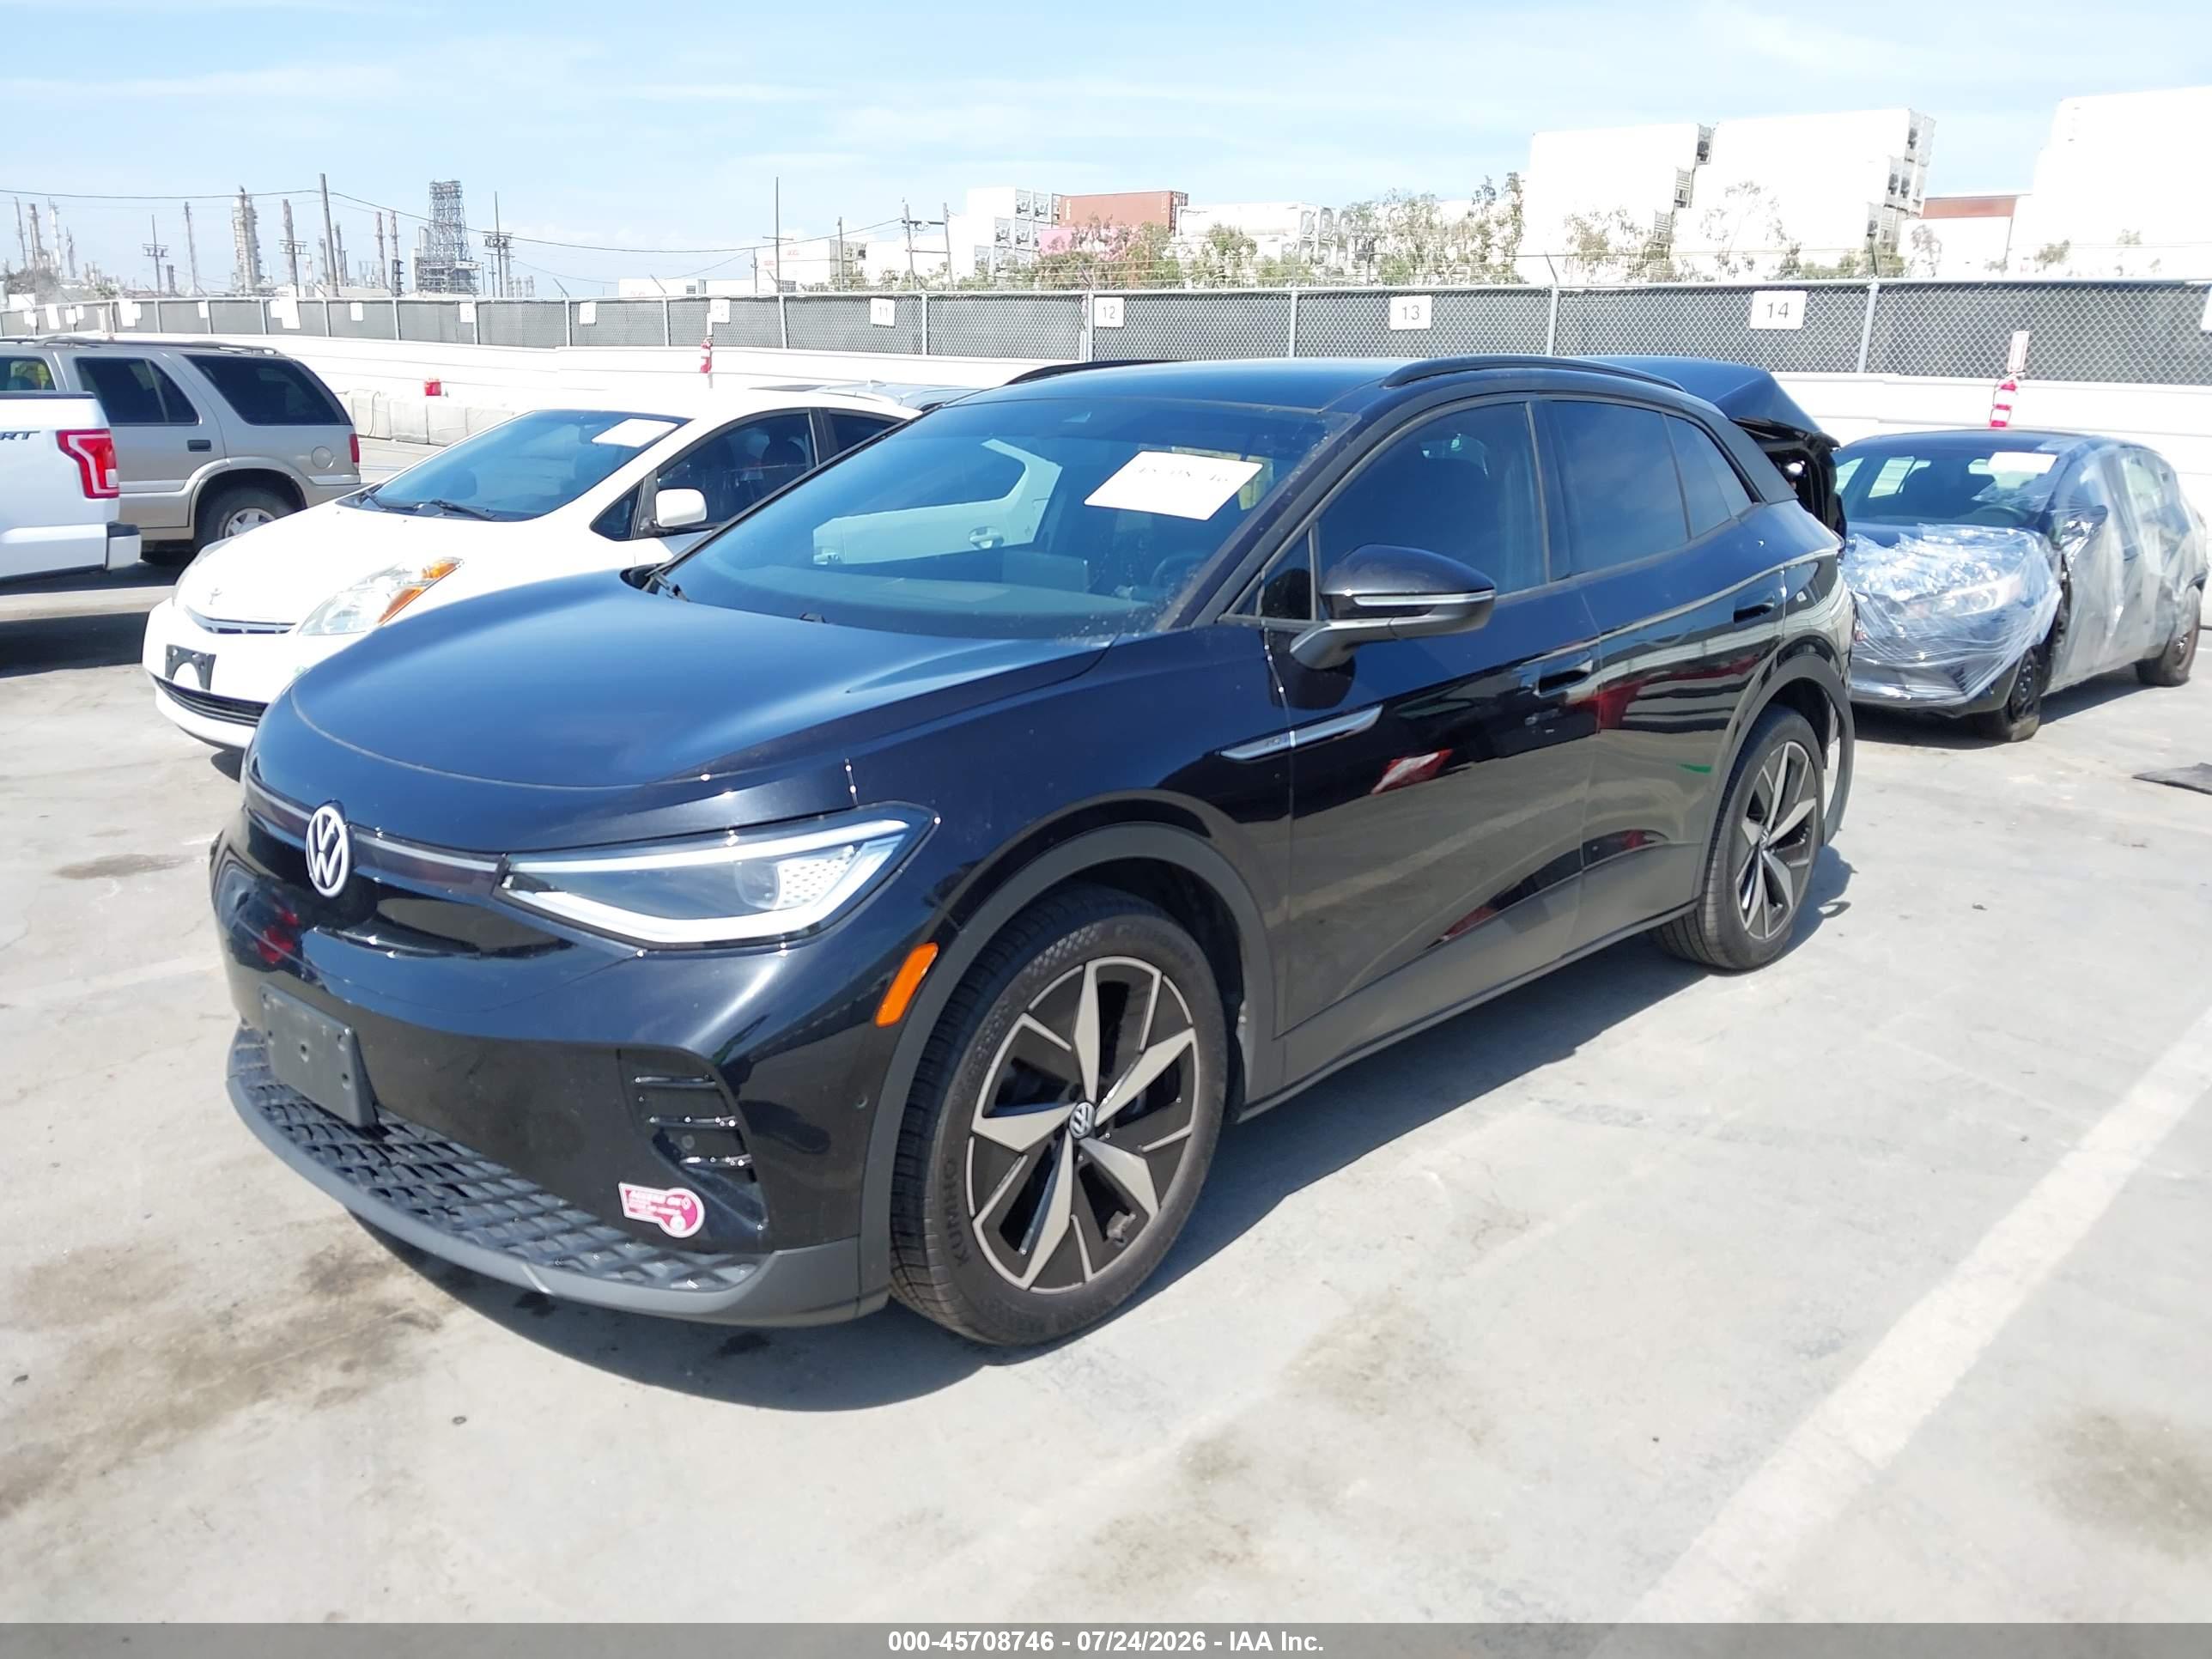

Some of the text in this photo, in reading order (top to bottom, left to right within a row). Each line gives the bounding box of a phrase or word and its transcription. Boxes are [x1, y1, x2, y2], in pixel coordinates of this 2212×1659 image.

[1103, 305, 1115, 319] 12
[1401, 305, 1420, 320] 13
[1767, 301, 1789, 319] 14
